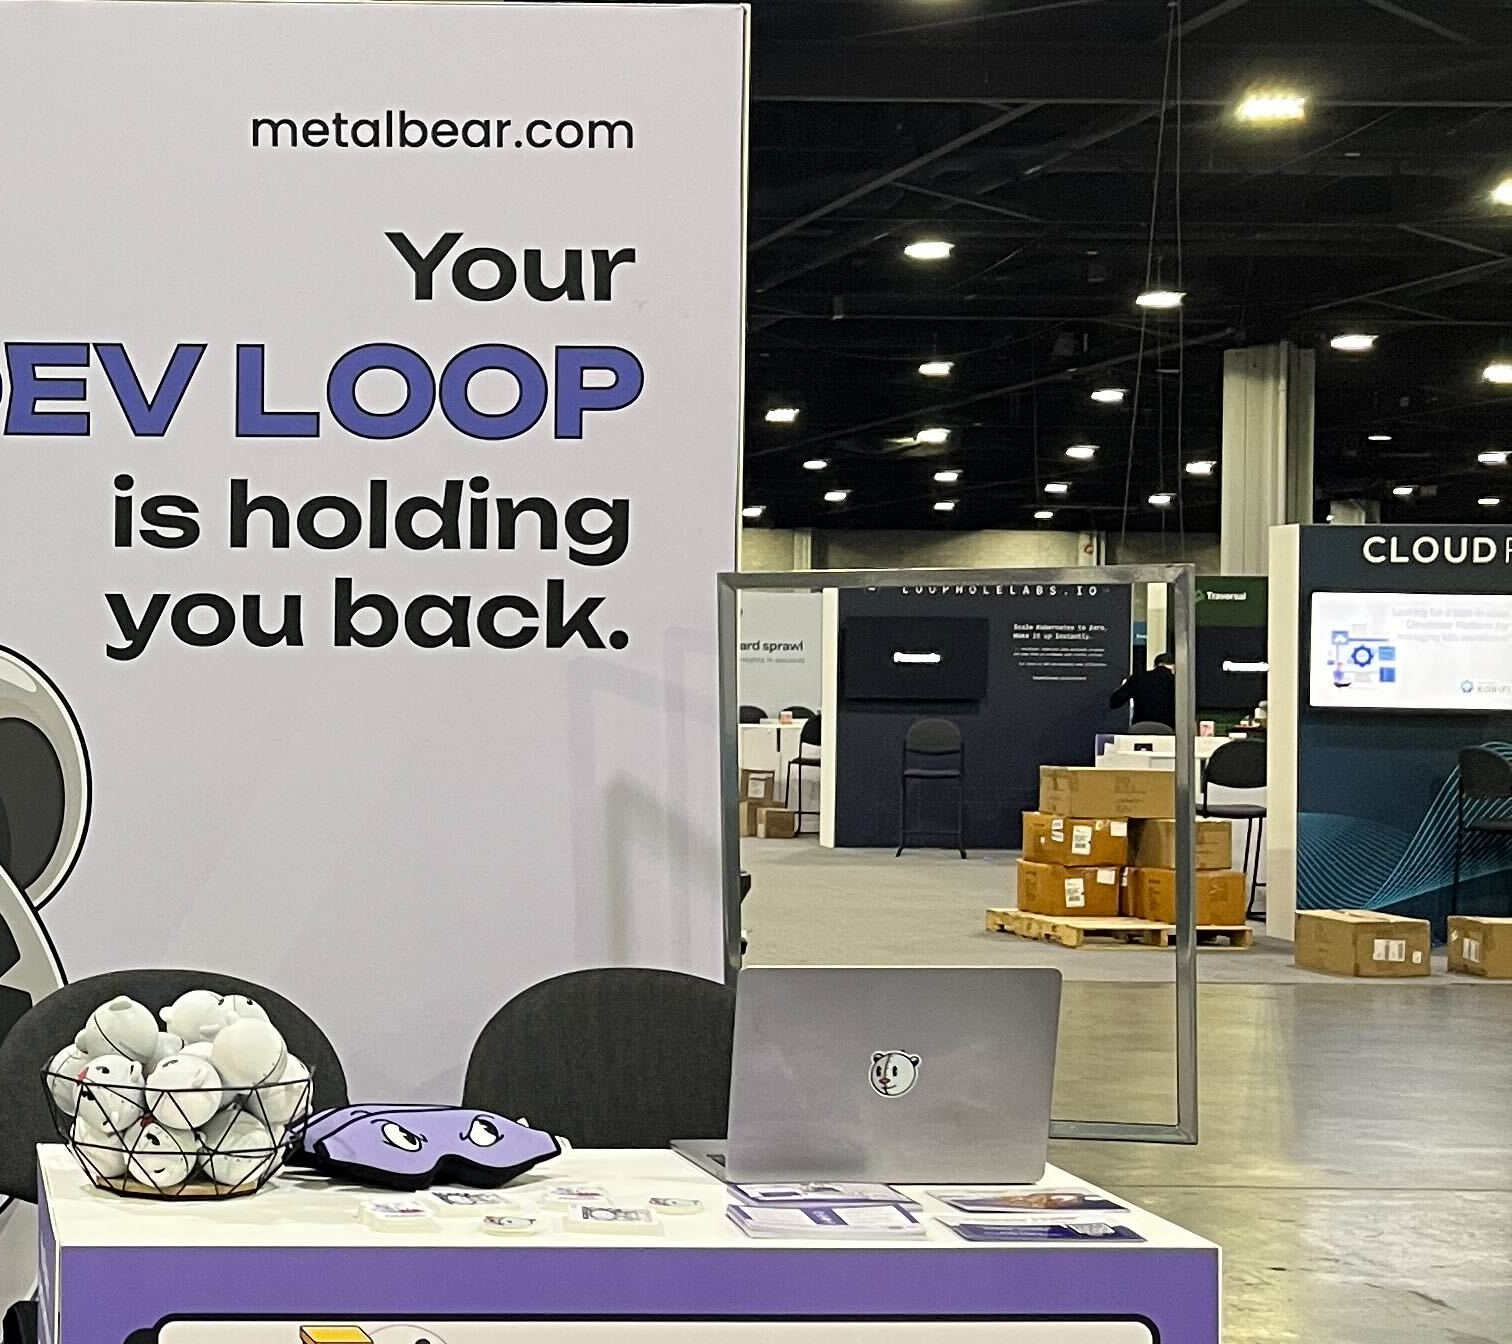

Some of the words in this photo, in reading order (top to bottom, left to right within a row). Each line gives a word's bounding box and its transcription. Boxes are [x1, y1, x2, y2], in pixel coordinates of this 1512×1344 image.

[253, 110, 633, 148] metalbear.com
[385, 232, 635, 301] Your
[236, 343, 644, 440] LOOP
[114, 474, 199, 548] is
[231, 476, 629, 566] holding
[105, 593, 303, 660] you
[335, 578, 628, 649] back.
